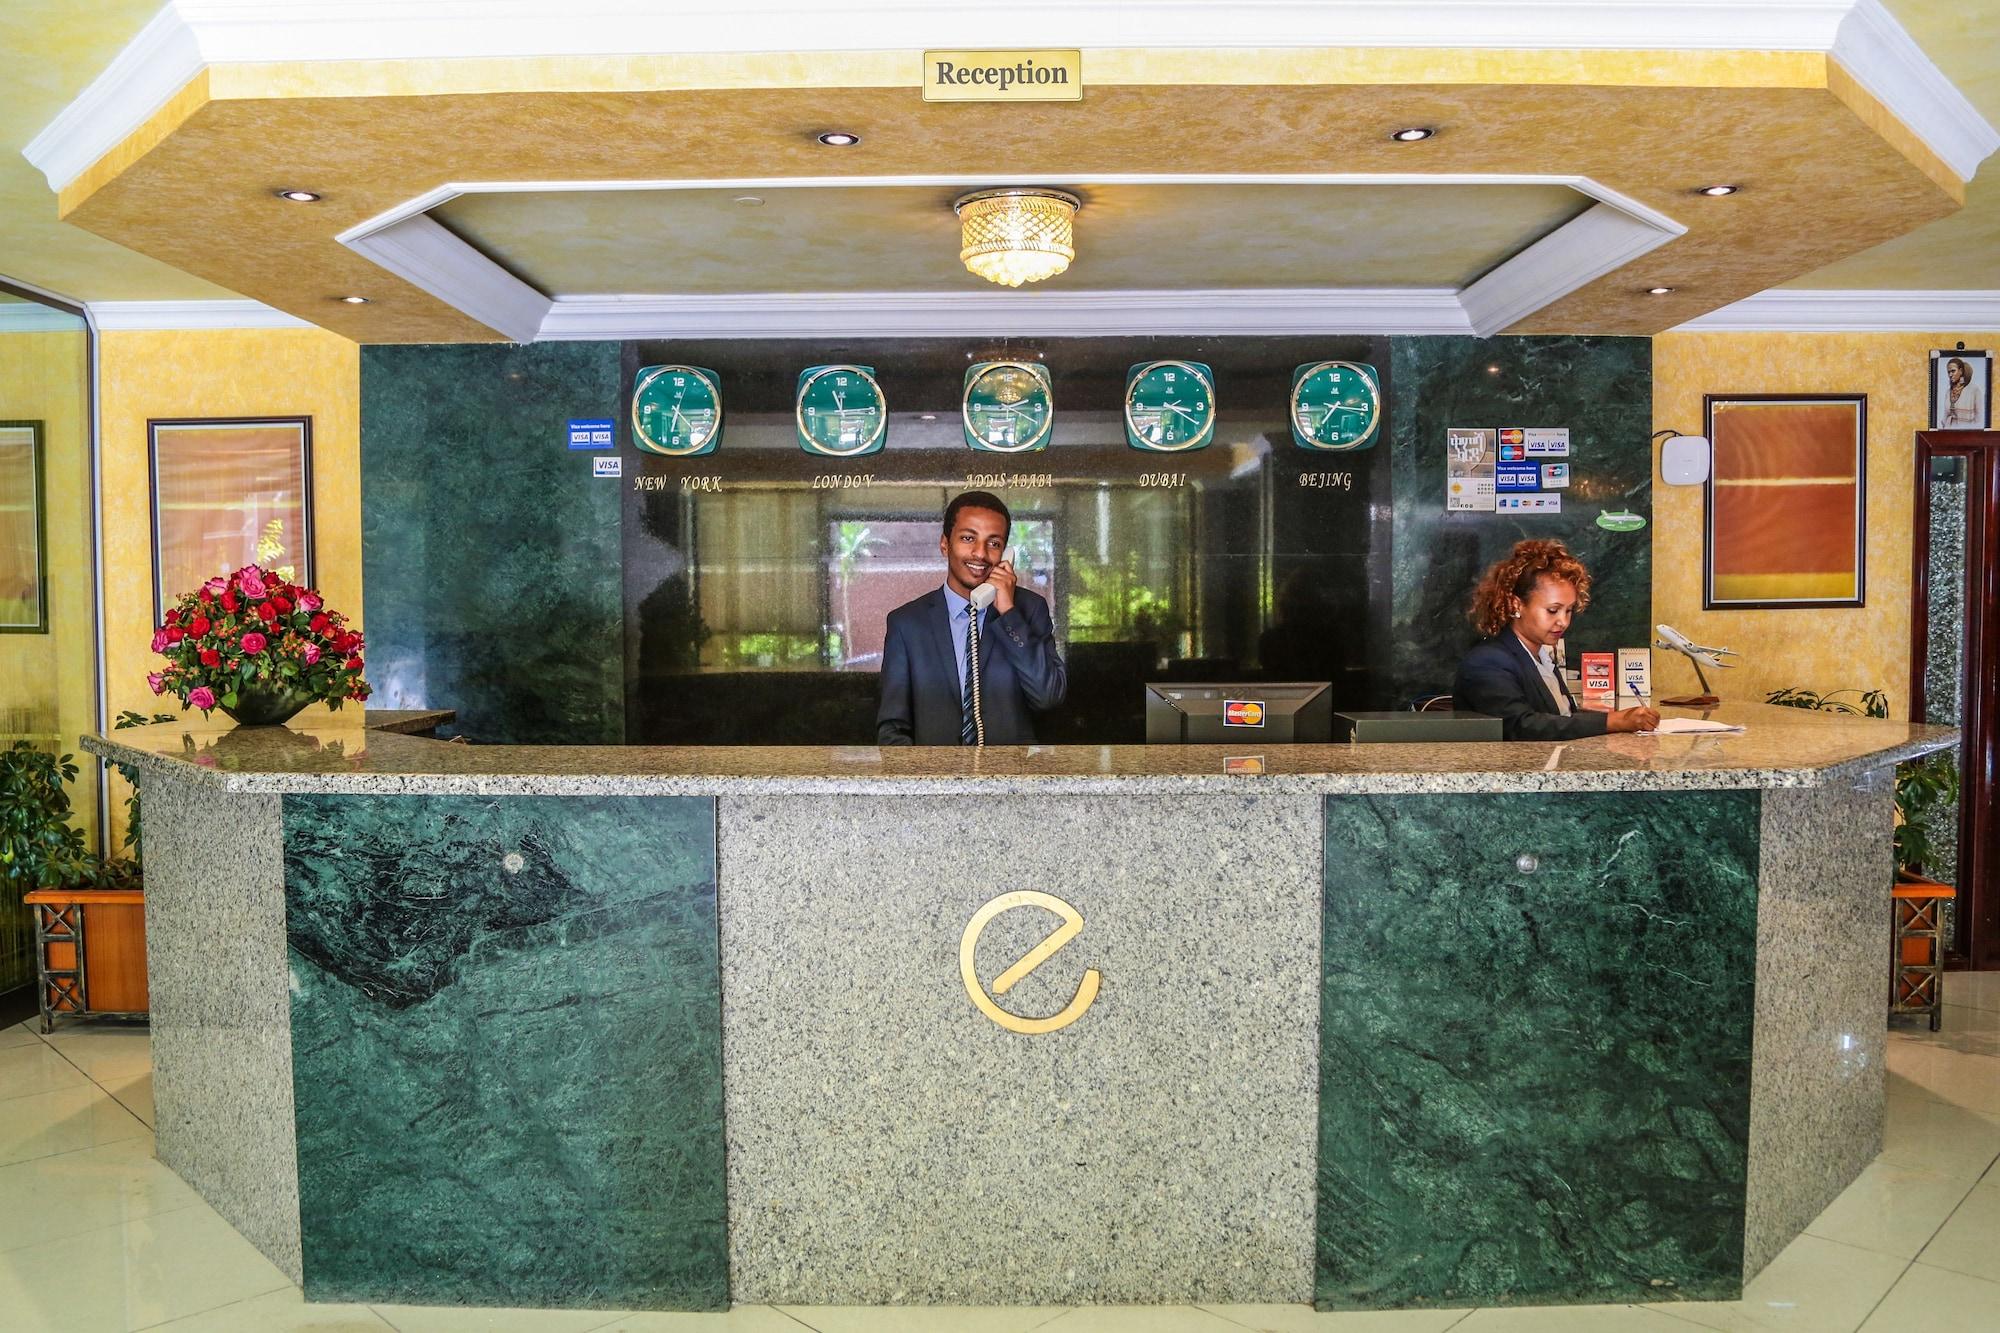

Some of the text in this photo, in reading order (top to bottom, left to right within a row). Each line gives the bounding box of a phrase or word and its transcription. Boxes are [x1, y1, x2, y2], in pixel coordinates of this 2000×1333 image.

[936, 59, 1069, 91] Reception
[673, 377, 685, 386] 12
[836, 377, 848, 386] 12
[1003, 374, 1014, 382] 12
[1164, 373, 1175, 382] 12
[1329, 373, 1340, 382] 12
[644, 405, 651, 414] 9
[808, 407, 815, 415] 9
[868, 406, 876, 415] 3
[974, 403, 982, 412] 9
[1034, 403, 1042, 412] 3
[1136, 402, 1144, 411] 9
[1196, 402, 1204, 411] 3
[1301, 402, 1309, 411] 9
[1361, 402, 1369, 411] 3
[703, 408, 711, 417] 3
[672, 436, 680, 445] 6
[1166, 432, 1174, 440] 6
[1331, 432, 1339, 440] 6
[598, 461, 619, 469] VISA
[634, 474, 723, 492] NEW YORK
[964, 472, 1052, 490] ADDIS ABABA
[1139, 472, 1186, 488] DUBAI
[1299, 472, 1353, 491] BEJING
